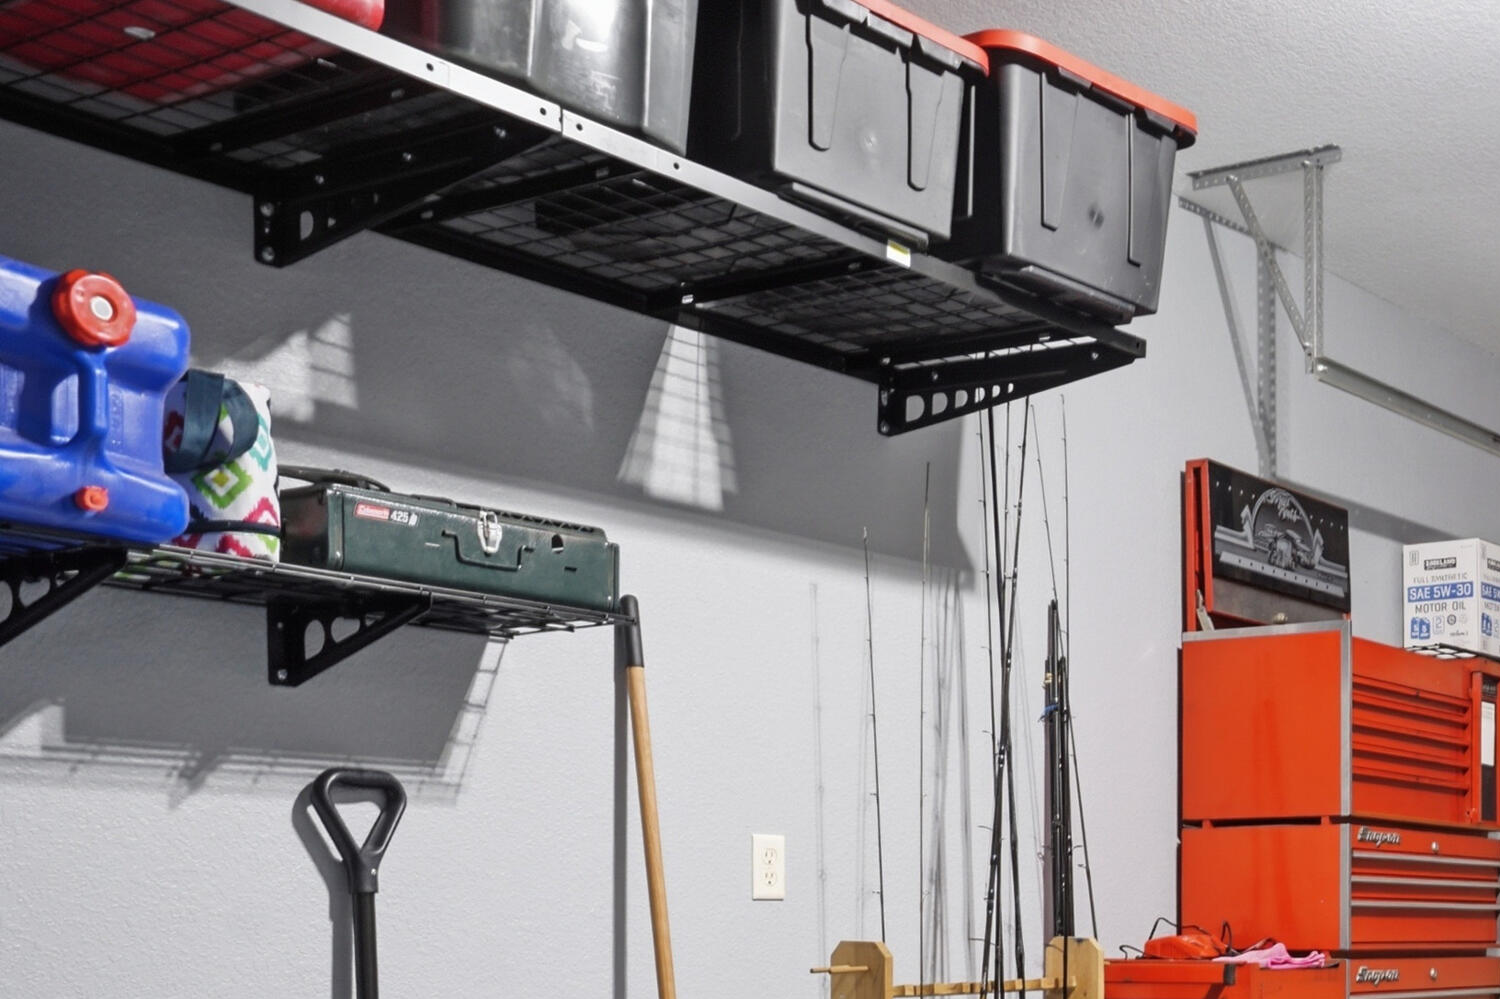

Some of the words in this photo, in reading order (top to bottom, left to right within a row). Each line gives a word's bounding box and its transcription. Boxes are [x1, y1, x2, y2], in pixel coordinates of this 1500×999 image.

[391, 510, 409, 523] 425
[1409, 587, 1431, 600] SAE
[1433, 583, 1472, 599] 5W-30
[1415, 602, 1447, 614] MOTOR
[1452, 600, 1466, 611] OIL
